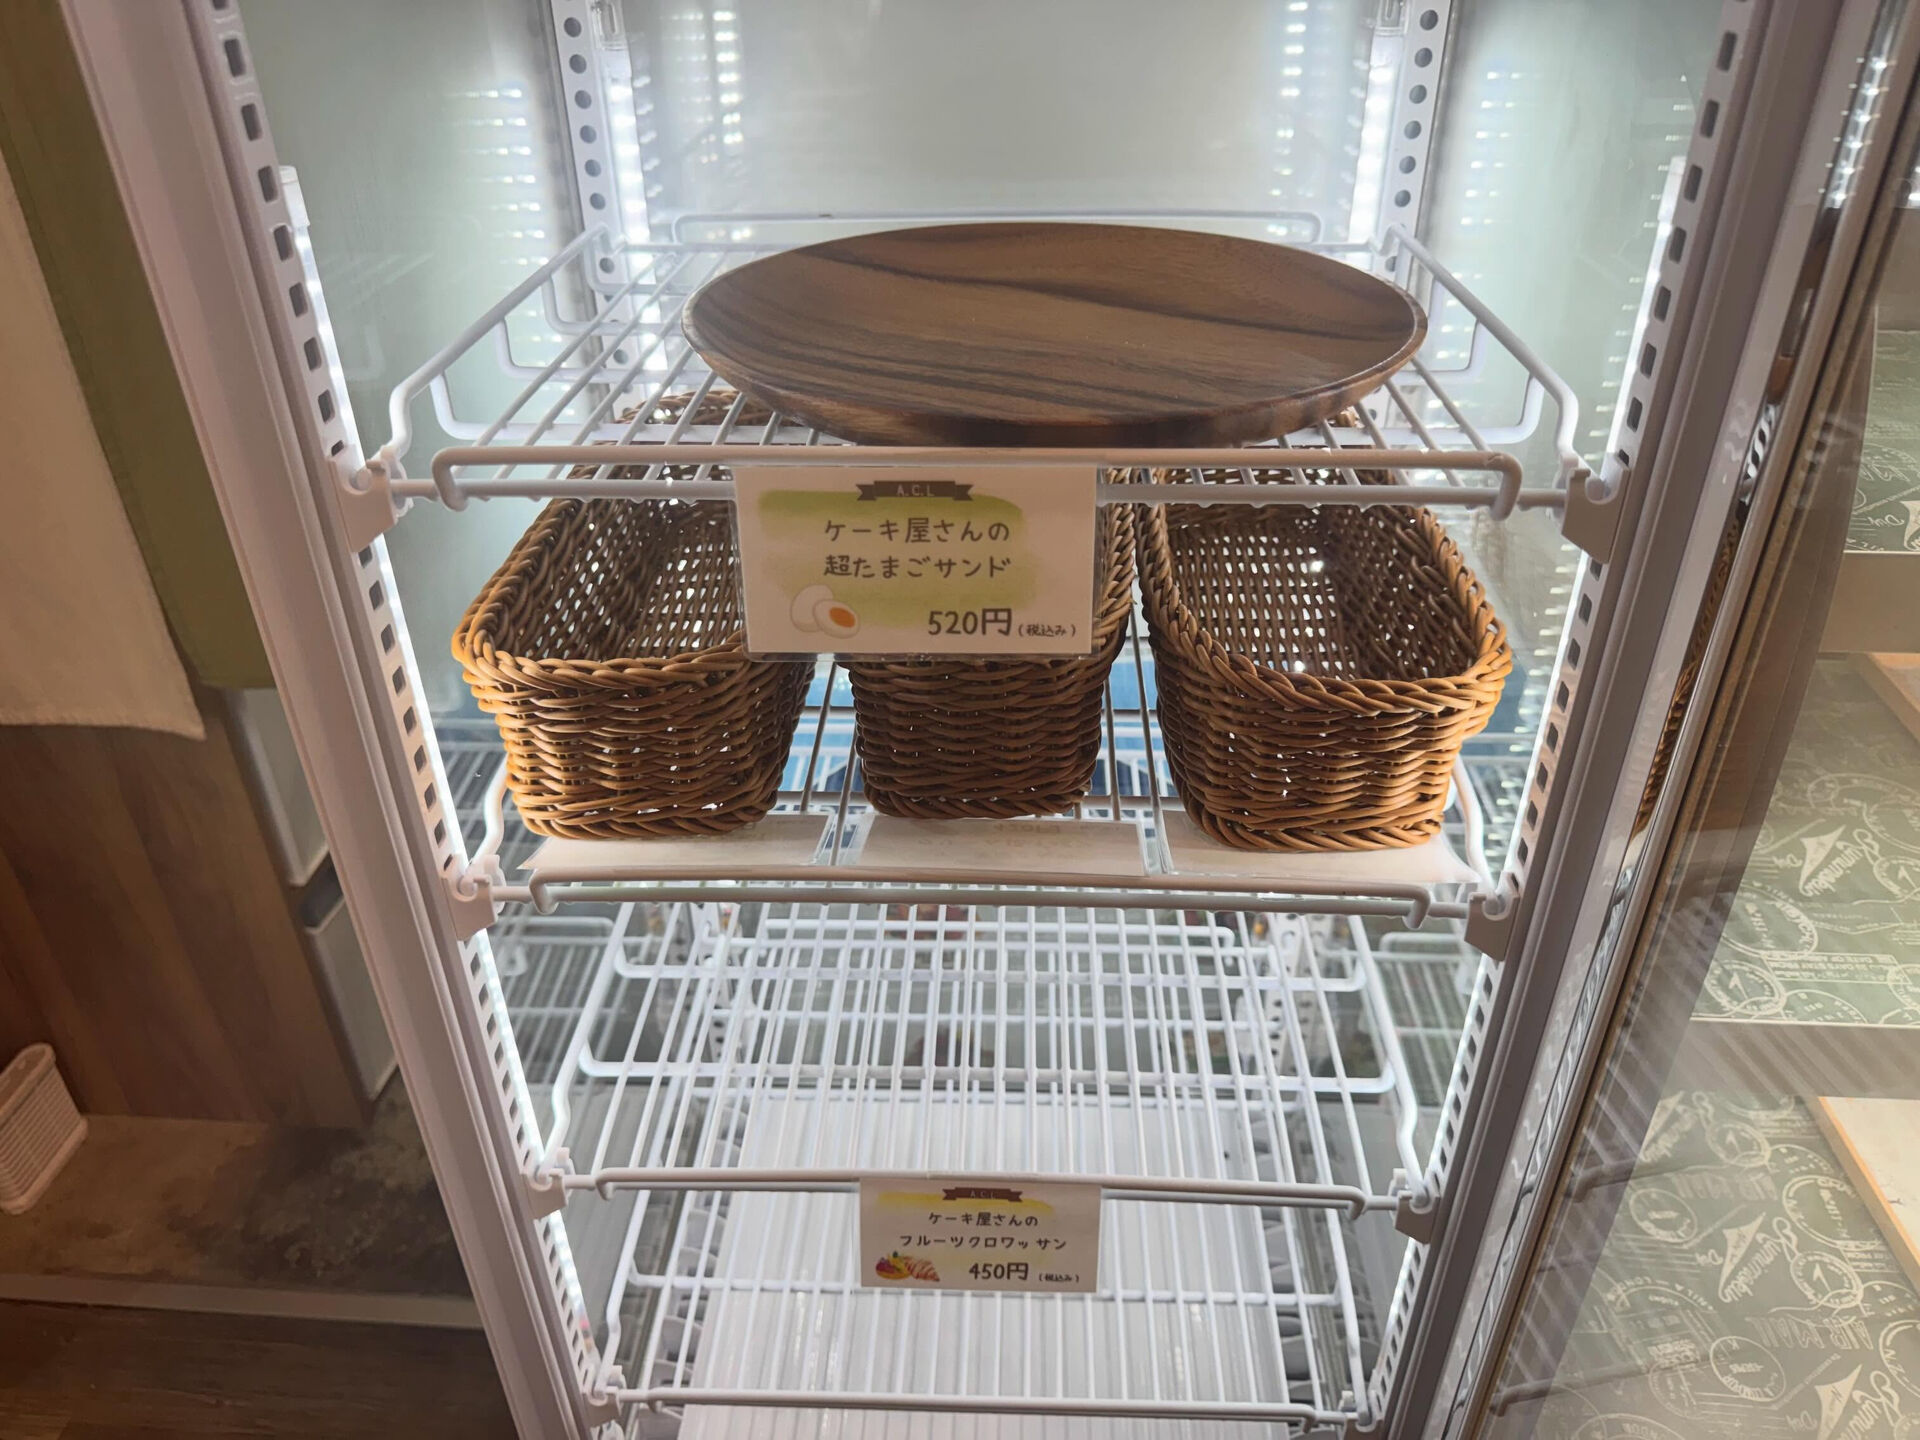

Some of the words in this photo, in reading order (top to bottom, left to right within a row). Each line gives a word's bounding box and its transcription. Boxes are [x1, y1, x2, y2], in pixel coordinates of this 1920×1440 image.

[823, 517, 1011, 544] ケーキ屋さんの
[823, 555, 1011, 579] 超たまごサンド
[927, 608, 1013, 636] 520円
[928, 1212, 1039, 1228] ケーキ屋さんの
[899, 1235, 1068, 1251] フルーツクロワッサン
[968, 1262, 1029, 1281] 450円
